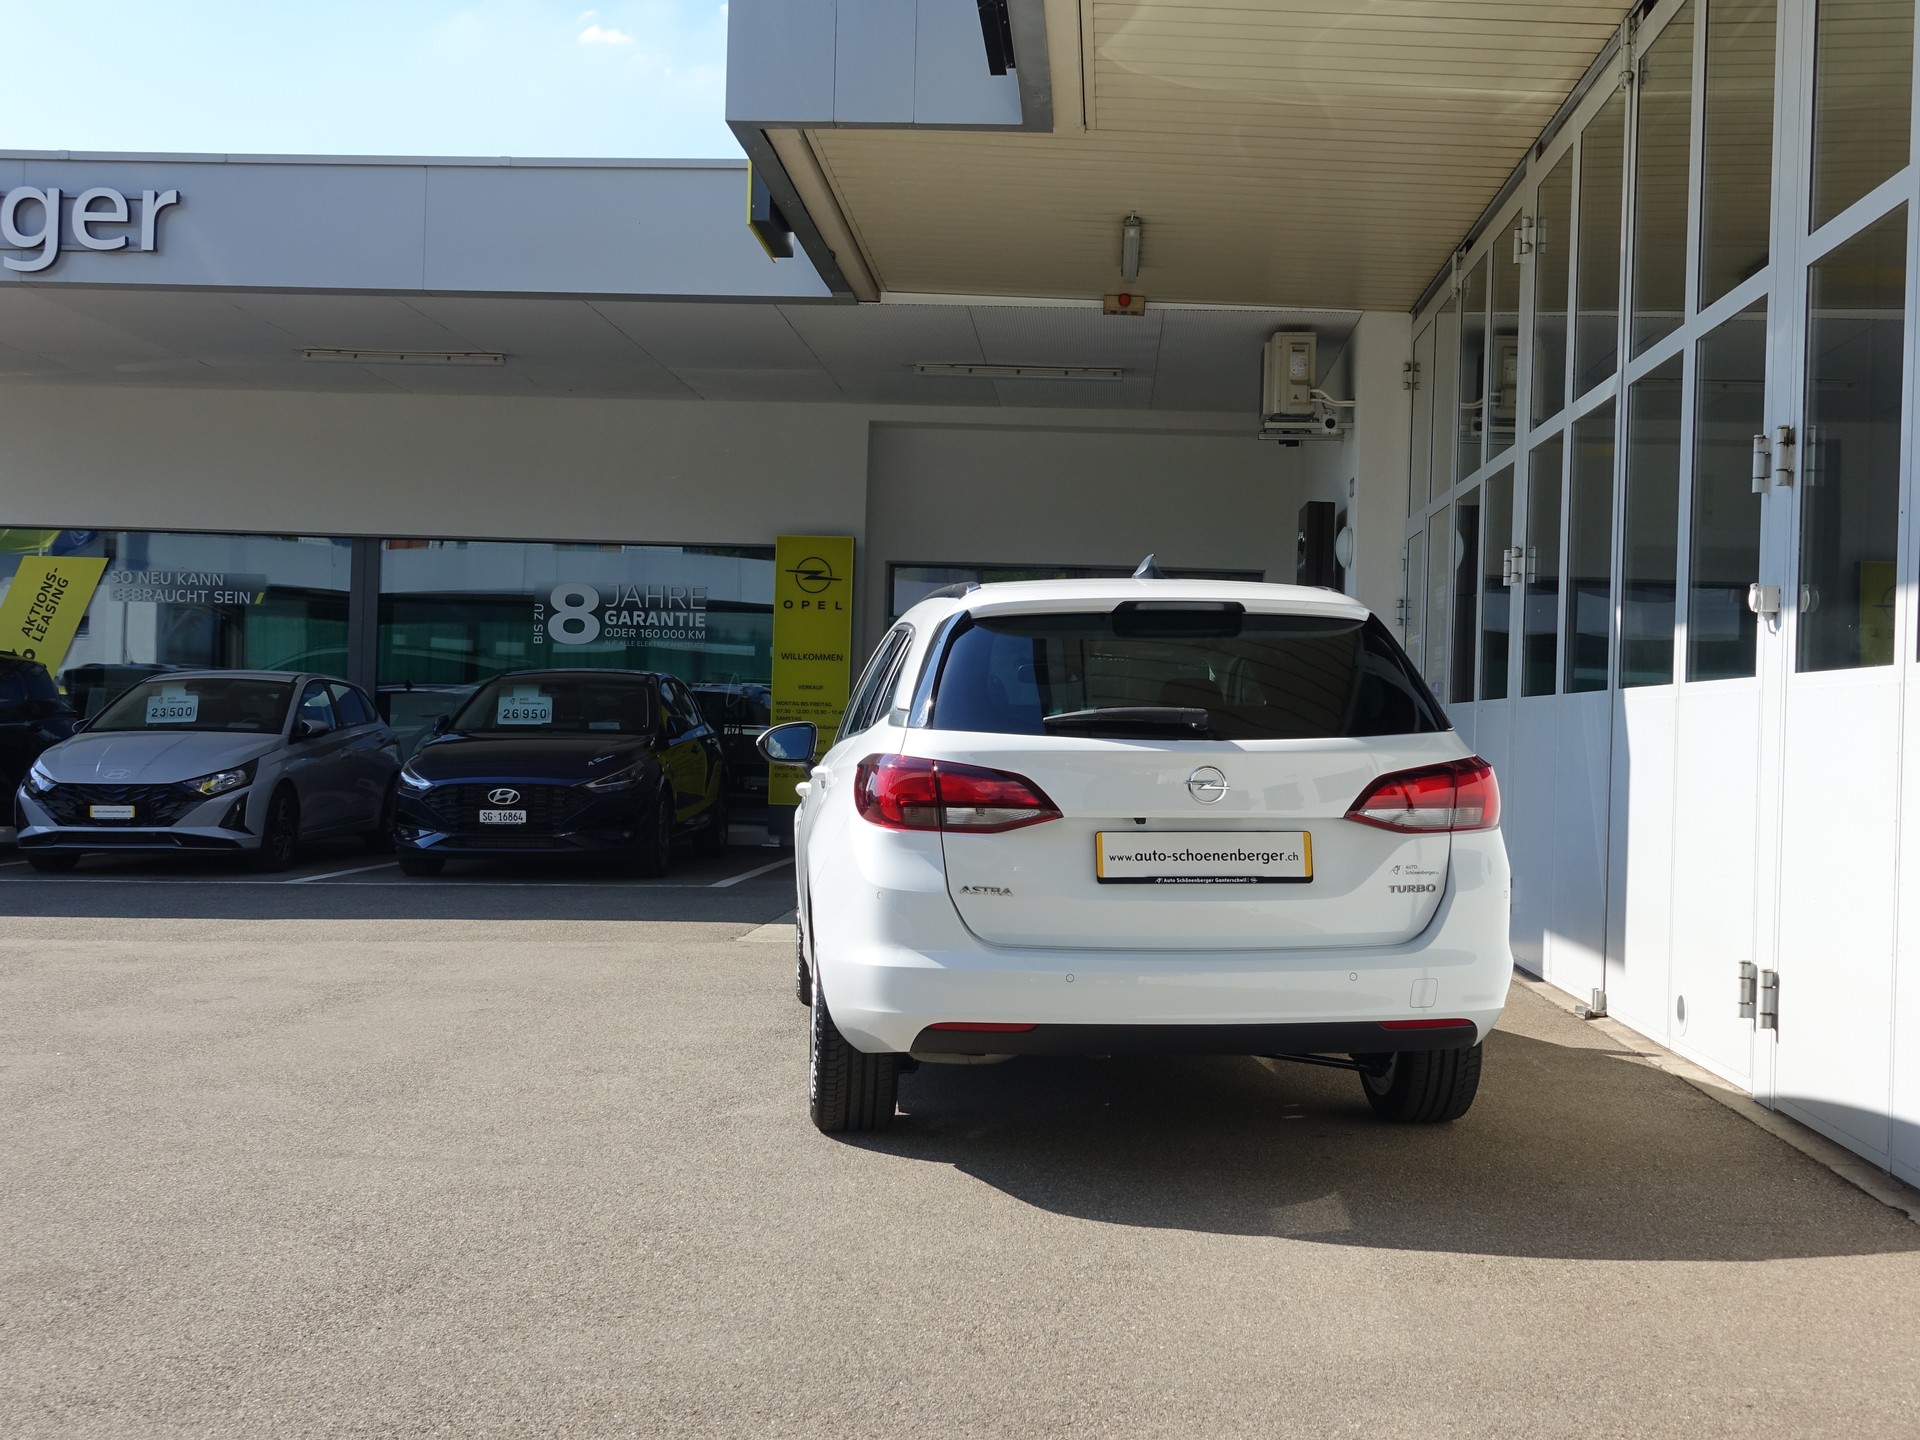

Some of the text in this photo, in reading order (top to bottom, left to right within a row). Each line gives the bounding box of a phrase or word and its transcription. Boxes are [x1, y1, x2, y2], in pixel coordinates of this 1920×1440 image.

[110, 571, 224, 586] SO NEU KANN
[22, 567, 58, 637] AKTIONS-
[111, 588, 250, 604] GEBRAUCHT SEIN
[605, 584, 707, 610] JAHRE
[32, 577, 69, 642] LEASING
[783, 600, 843, 611] OPEL
[548, 583, 600, 645] 8
[604, 610, 706, 627] GARANTIE
[533, 603, 544, 644] BIS ZU
[604, 628, 706, 640] ODER 160 000 KM
[781, 653, 843, 661] WILLKOMMEN
[1109, 848, 1299, 864] www.auto-schoenenberger.ch
[960, 885, 1013, 897] ASTRA
[1388, 884, 1436, 893] TURBO
